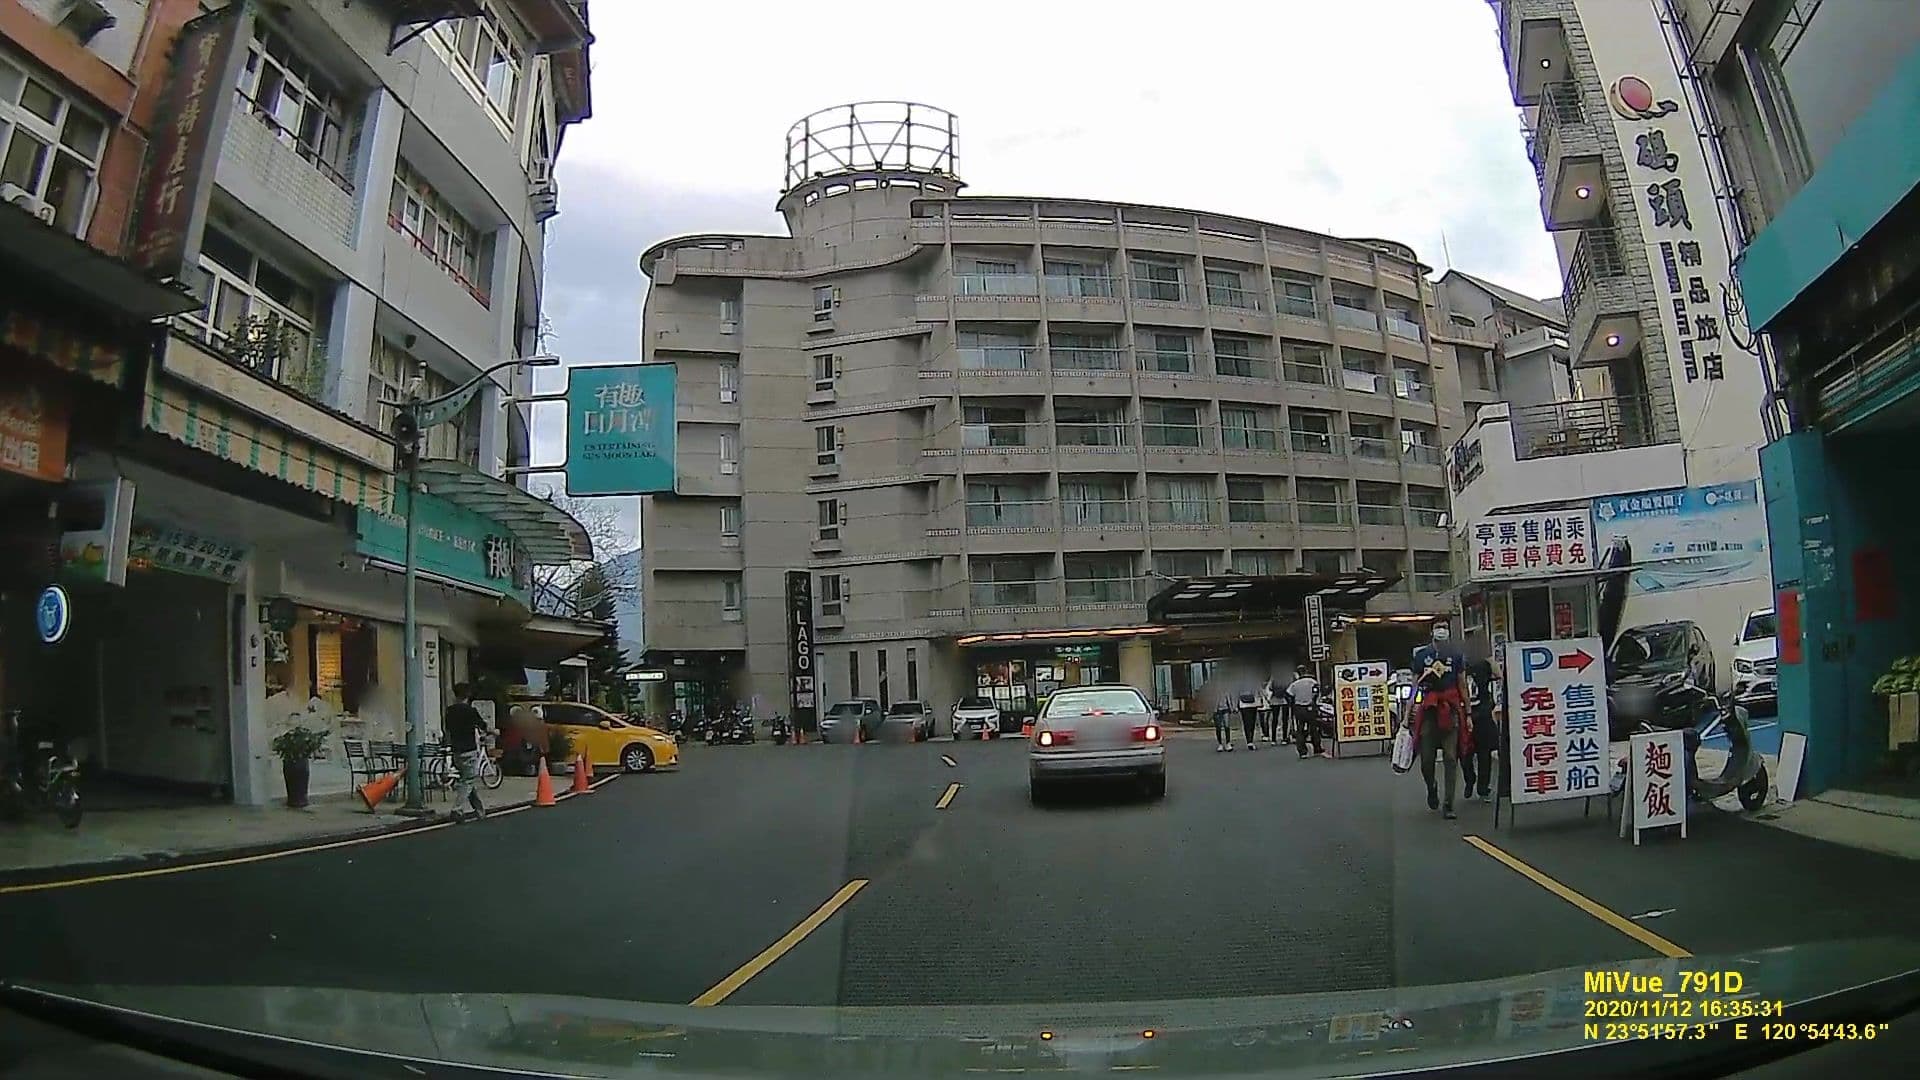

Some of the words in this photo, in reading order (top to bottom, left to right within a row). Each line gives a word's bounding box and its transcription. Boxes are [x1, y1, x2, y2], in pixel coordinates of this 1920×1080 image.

[1636, 129, 1693, 231] 碼頭
[1678, 240, 1724, 382] 精品旅店
[594, 382, 645, 408] 有趣
[797, 610, 809, 670] LAGO
[1521, 647, 1554, 683] P
[1521, 687, 1559, 795] 免費停車
[1562, 683, 1600, 792] 售票坐船
